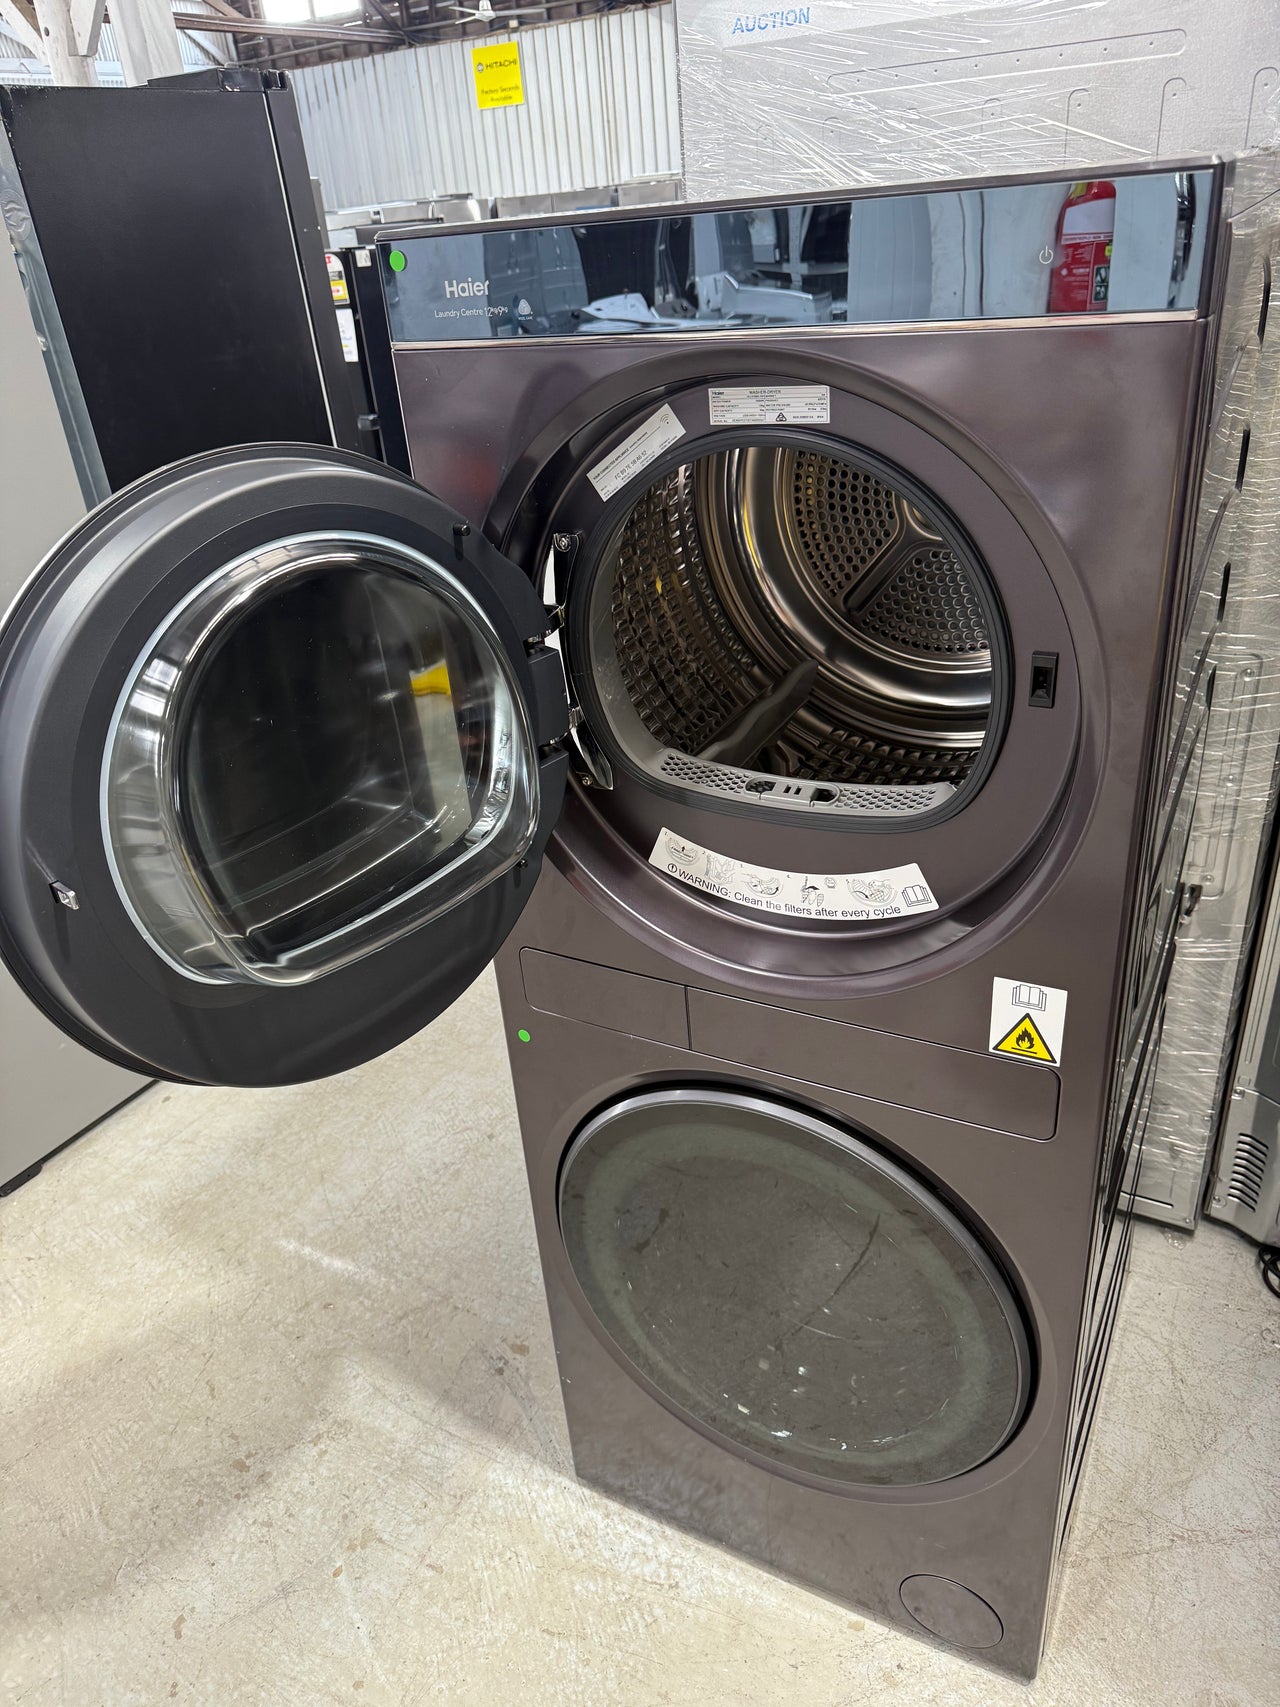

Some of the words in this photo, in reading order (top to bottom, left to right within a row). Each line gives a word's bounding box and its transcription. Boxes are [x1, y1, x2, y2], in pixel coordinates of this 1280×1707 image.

[732, 7, 810, 34] AUCTION
[486, 59, 517, 69] HITACHI
[444, 277, 490, 299] Haier
[434, 309, 460, 319] Laundry
[460, 308, 483, 317] Centre
[679, 869, 731, 898] WARNING:
[734, 891, 763, 906] Clean
[766, 900, 781, 911] the
[784, 903, 812, 916] filters
[815, 907, 838, 917] after
[841, 909, 870, 918] every
[873, 906, 901, 917] cycle
